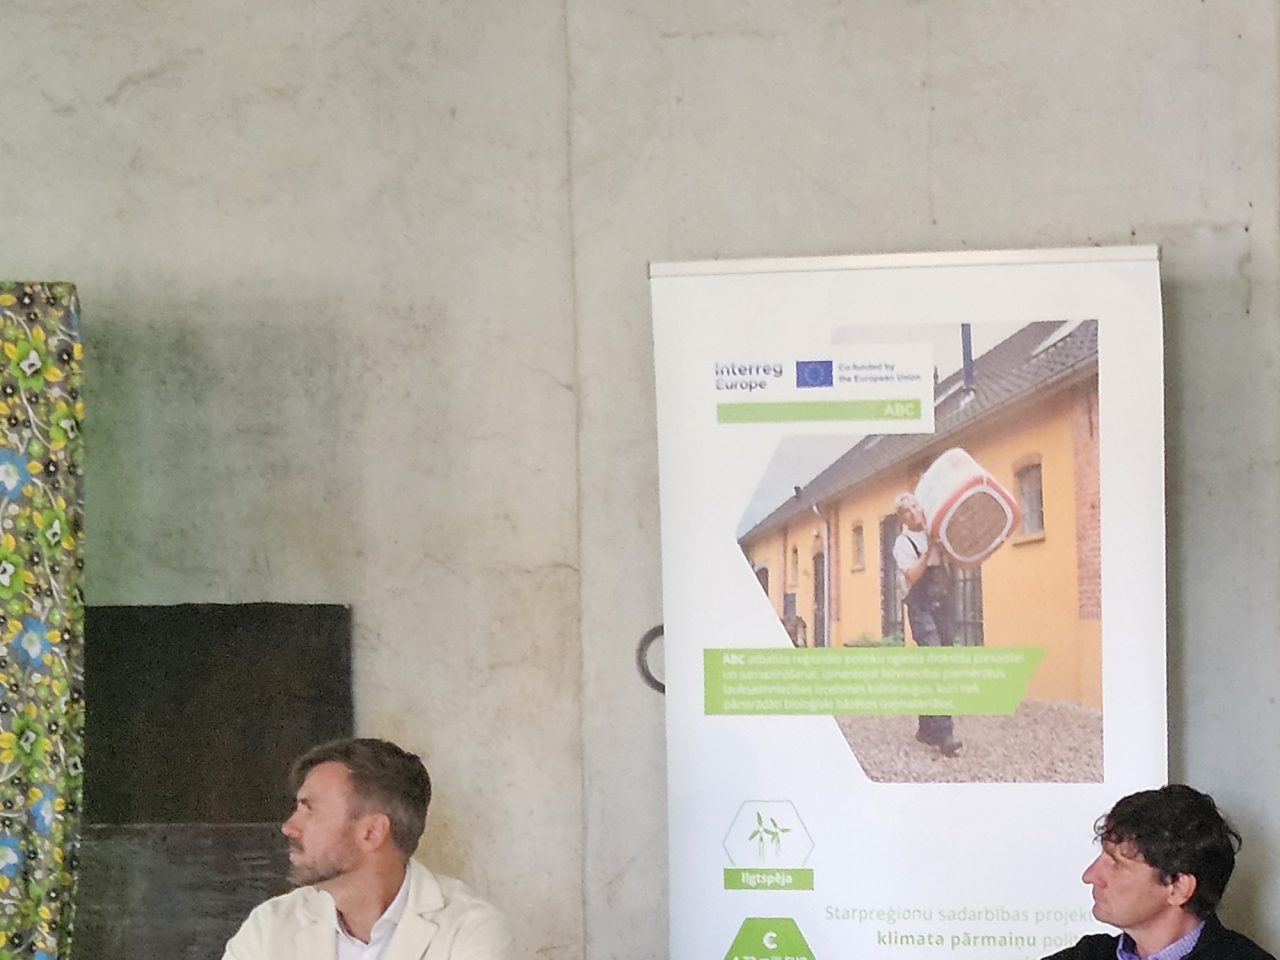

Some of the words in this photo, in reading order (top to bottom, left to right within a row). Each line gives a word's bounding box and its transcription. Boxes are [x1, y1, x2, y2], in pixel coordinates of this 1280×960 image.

[715, 362, 783, 378] Interreg
[716, 379, 767, 392] Europe
[884, 403, 914, 416] ABC
[741, 872, 793, 886] Ilgtspēja
[938, 905, 1029, 922] sadarbības
[1035, 906, 1093, 925] projekt
[877, 931, 944, 946] klimata
[951, 931, 1036, 950] pārmaiņu
